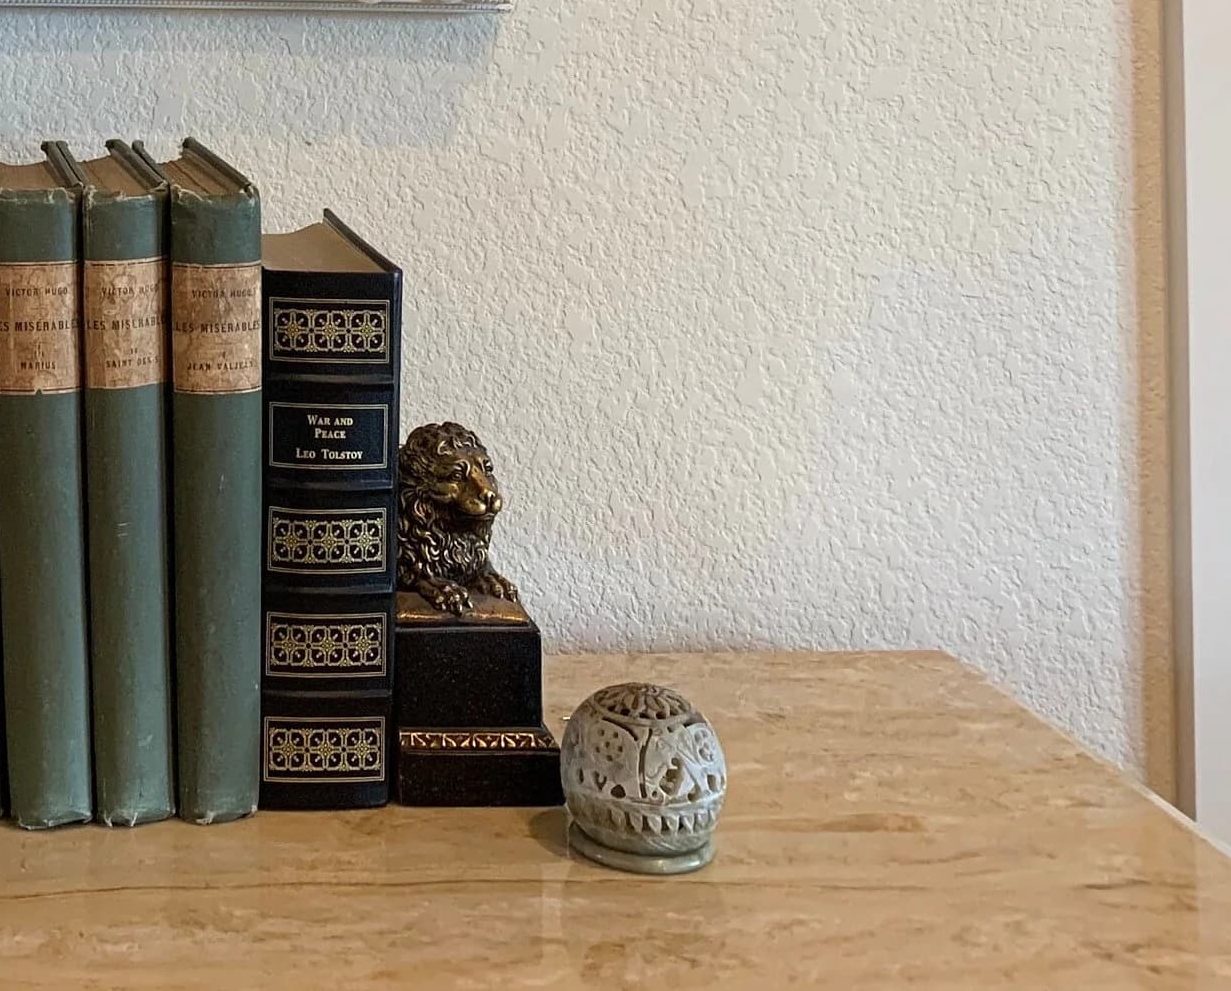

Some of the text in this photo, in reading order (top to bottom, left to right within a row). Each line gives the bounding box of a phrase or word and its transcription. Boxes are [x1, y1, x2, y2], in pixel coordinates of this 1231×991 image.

[5, 287, 39, 297] VICTOR
[87, 320, 106, 331] LES
[176, 321, 195, 333] LES
[20, 361, 57, 371] MARIUS
